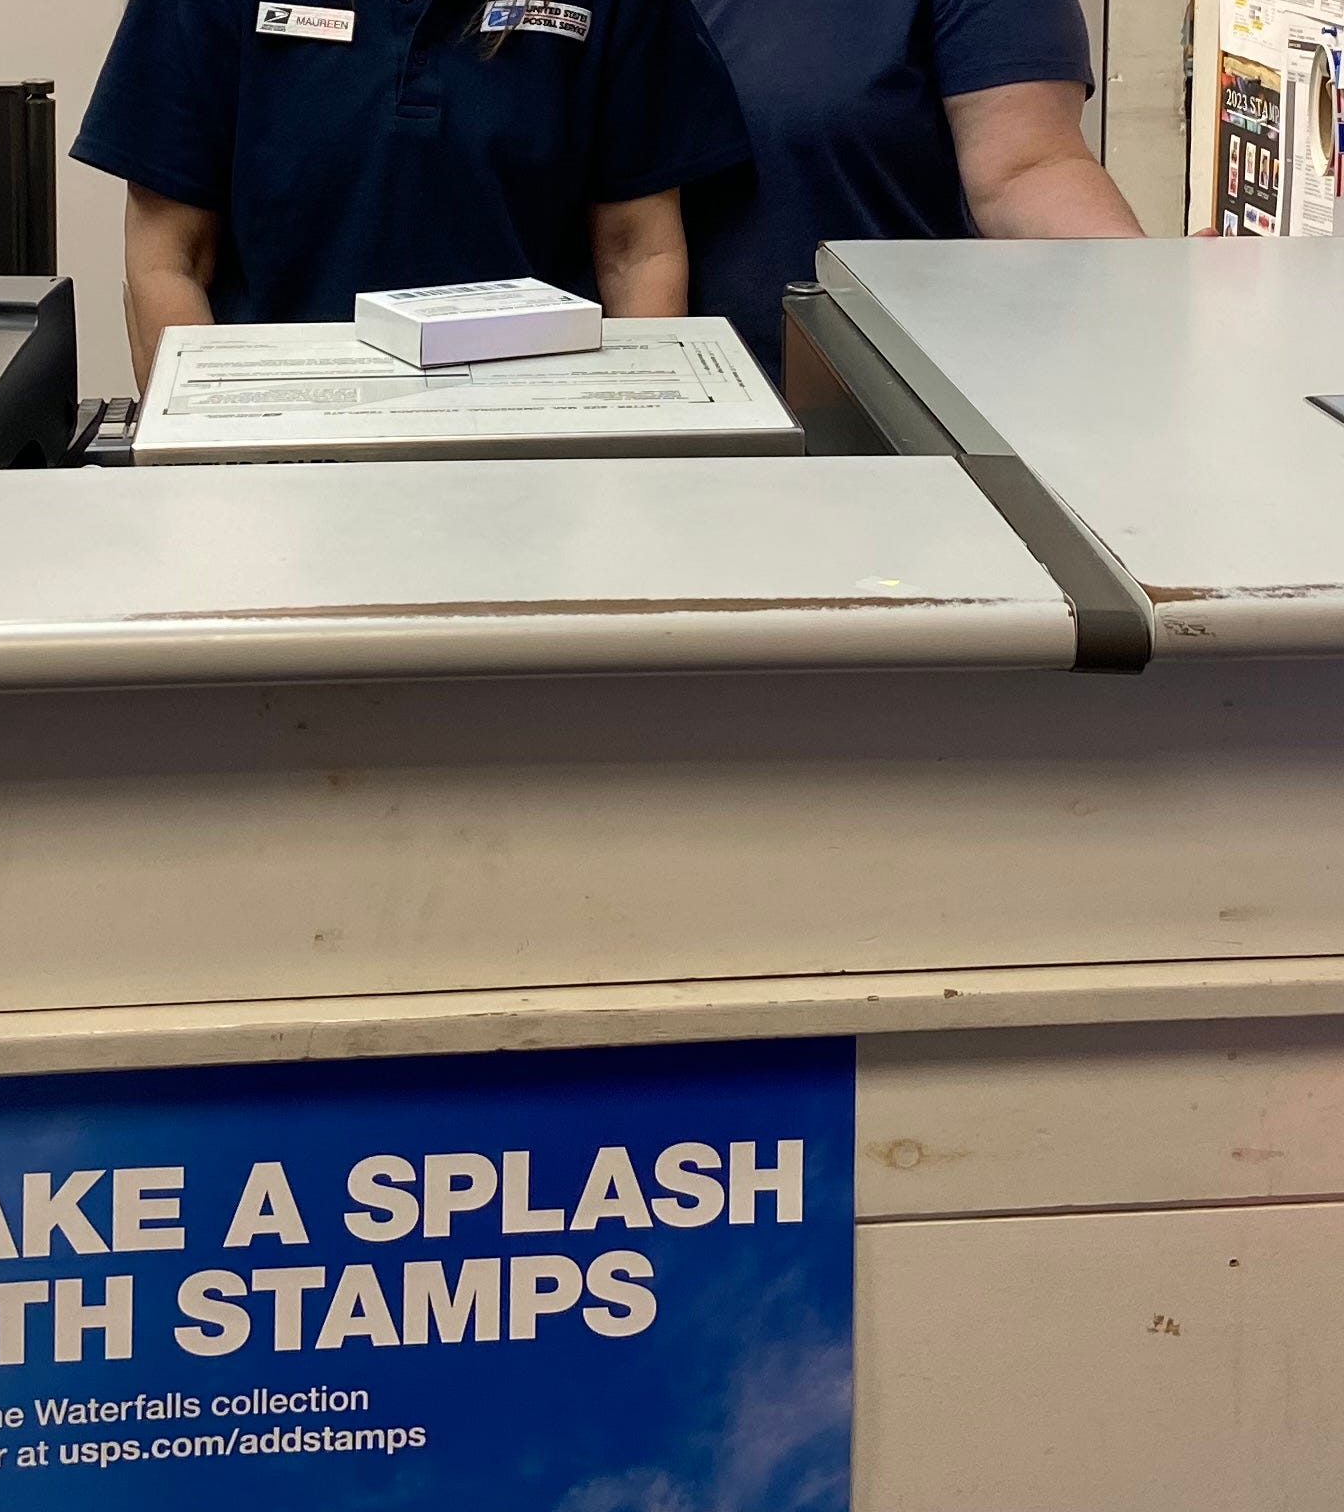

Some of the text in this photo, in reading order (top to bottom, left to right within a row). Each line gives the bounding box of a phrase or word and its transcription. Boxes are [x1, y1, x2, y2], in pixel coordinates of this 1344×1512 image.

[295, 17, 349, 30] MAUREEN
[523, 16, 558, 30] POSTAL
[524, 6, 561, 16] UNITED
[1225, 89, 1248, 111] 2023
[223, 1159, 310, 1250] A
[342, 1137, 805, 1246] SPLASH
[173, 1248, 657, 1360] STAMPS
[33, 1391, 201, 1426] Waterfalls
[211, 1385, 369, 1417] collection
[17, 1440, 50, 1468] at
[59, 1422, 427, 1467] usps.com/addstamps
